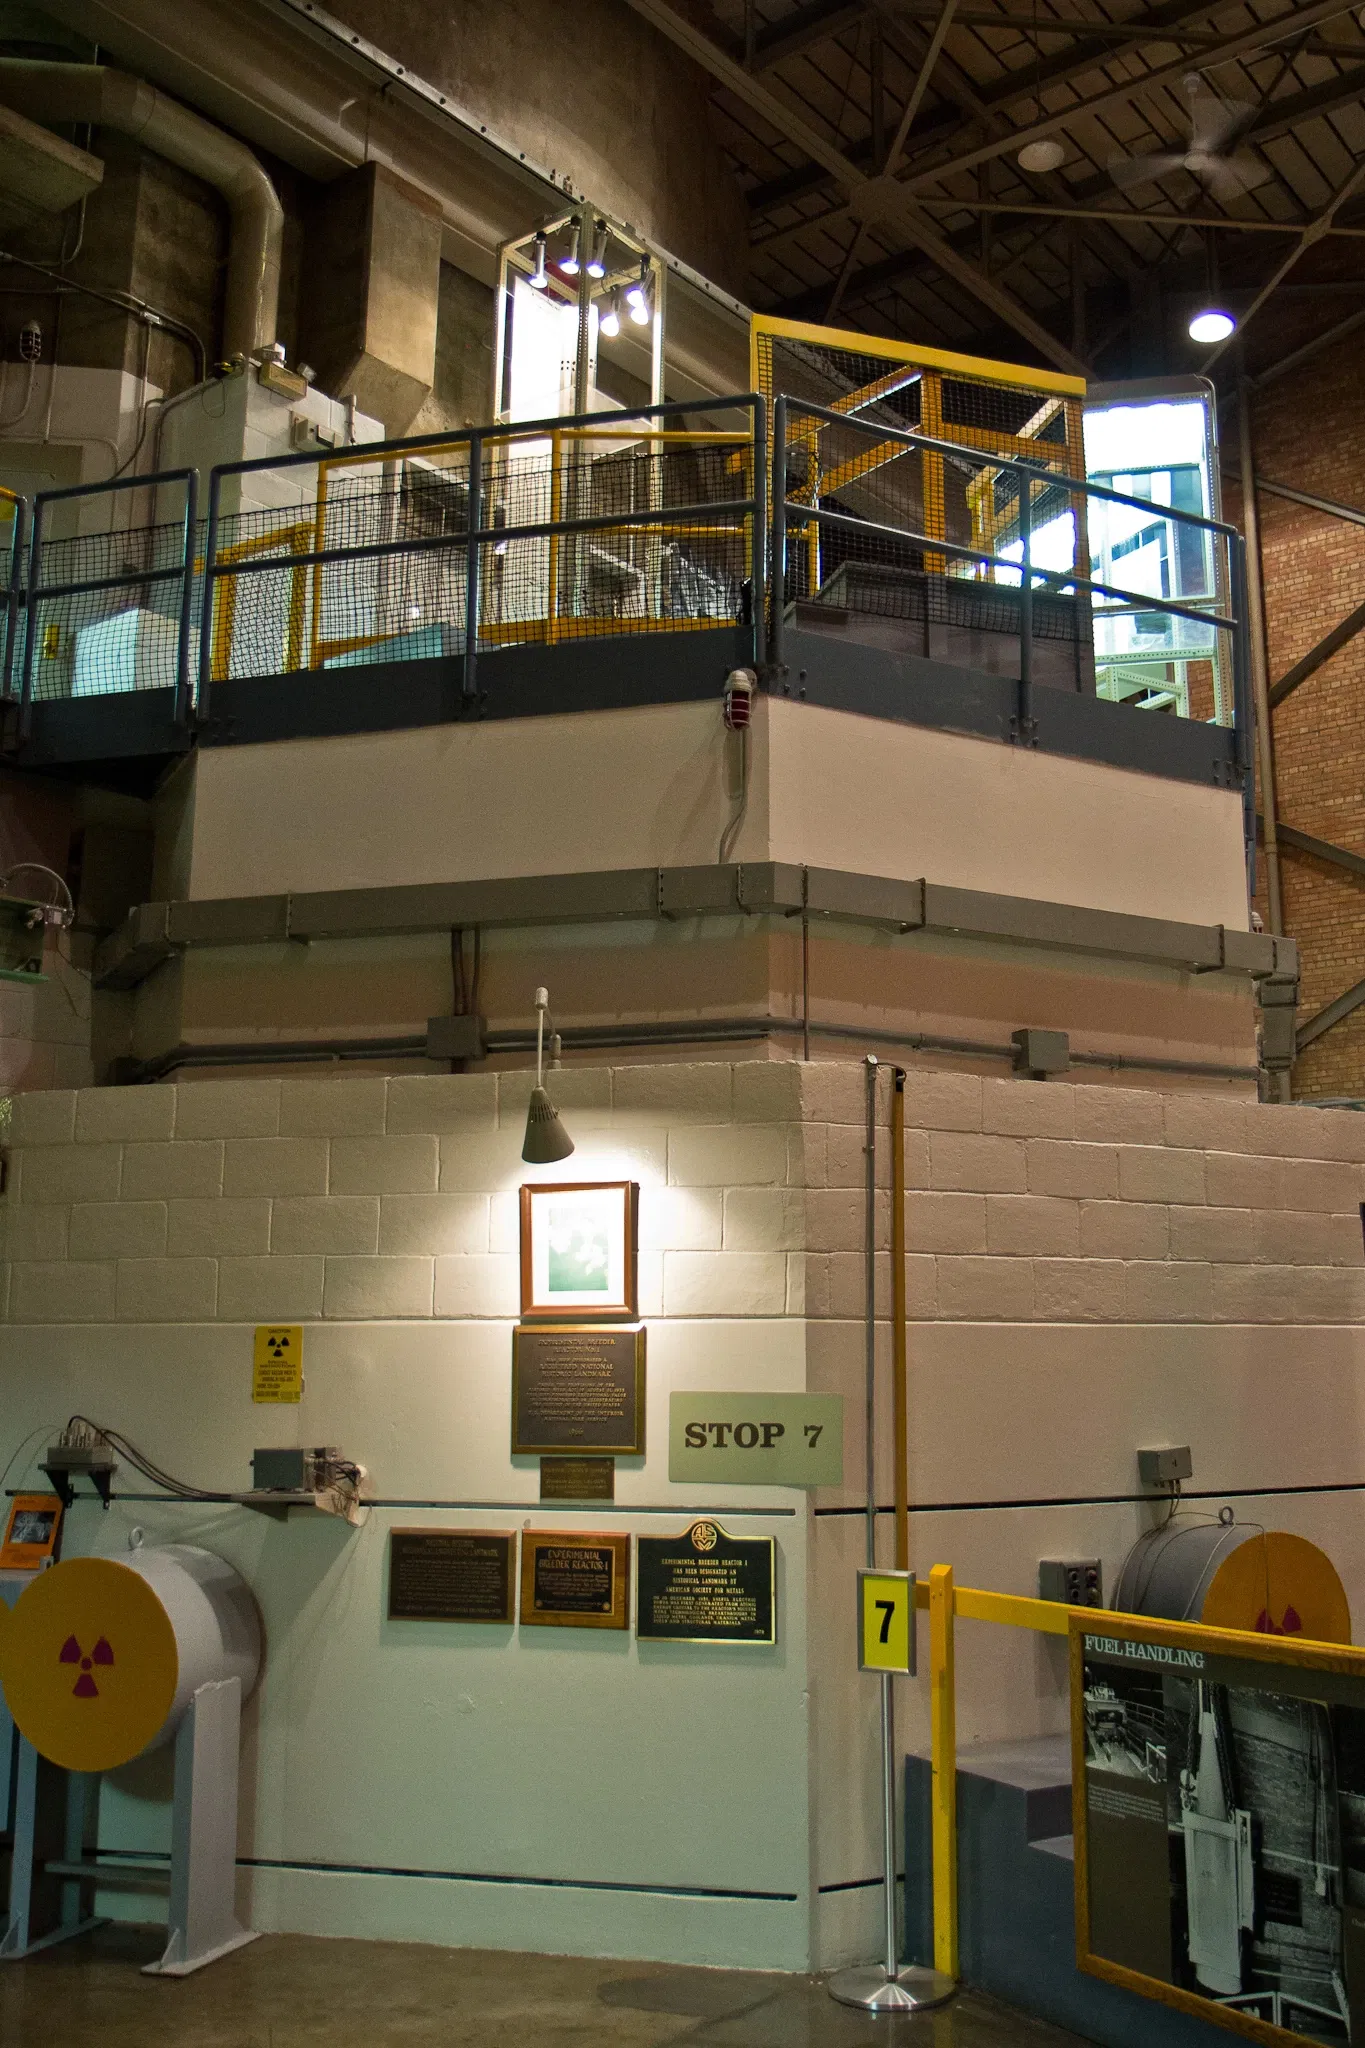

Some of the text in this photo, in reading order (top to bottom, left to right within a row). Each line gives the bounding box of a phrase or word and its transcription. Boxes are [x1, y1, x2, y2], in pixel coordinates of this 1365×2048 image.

[684, 1422, 824, 1449] STOP 7
[875, 1599, 895, 1644] 7
[1084, 1634, 1205, 1669] FUEL HANDLING
